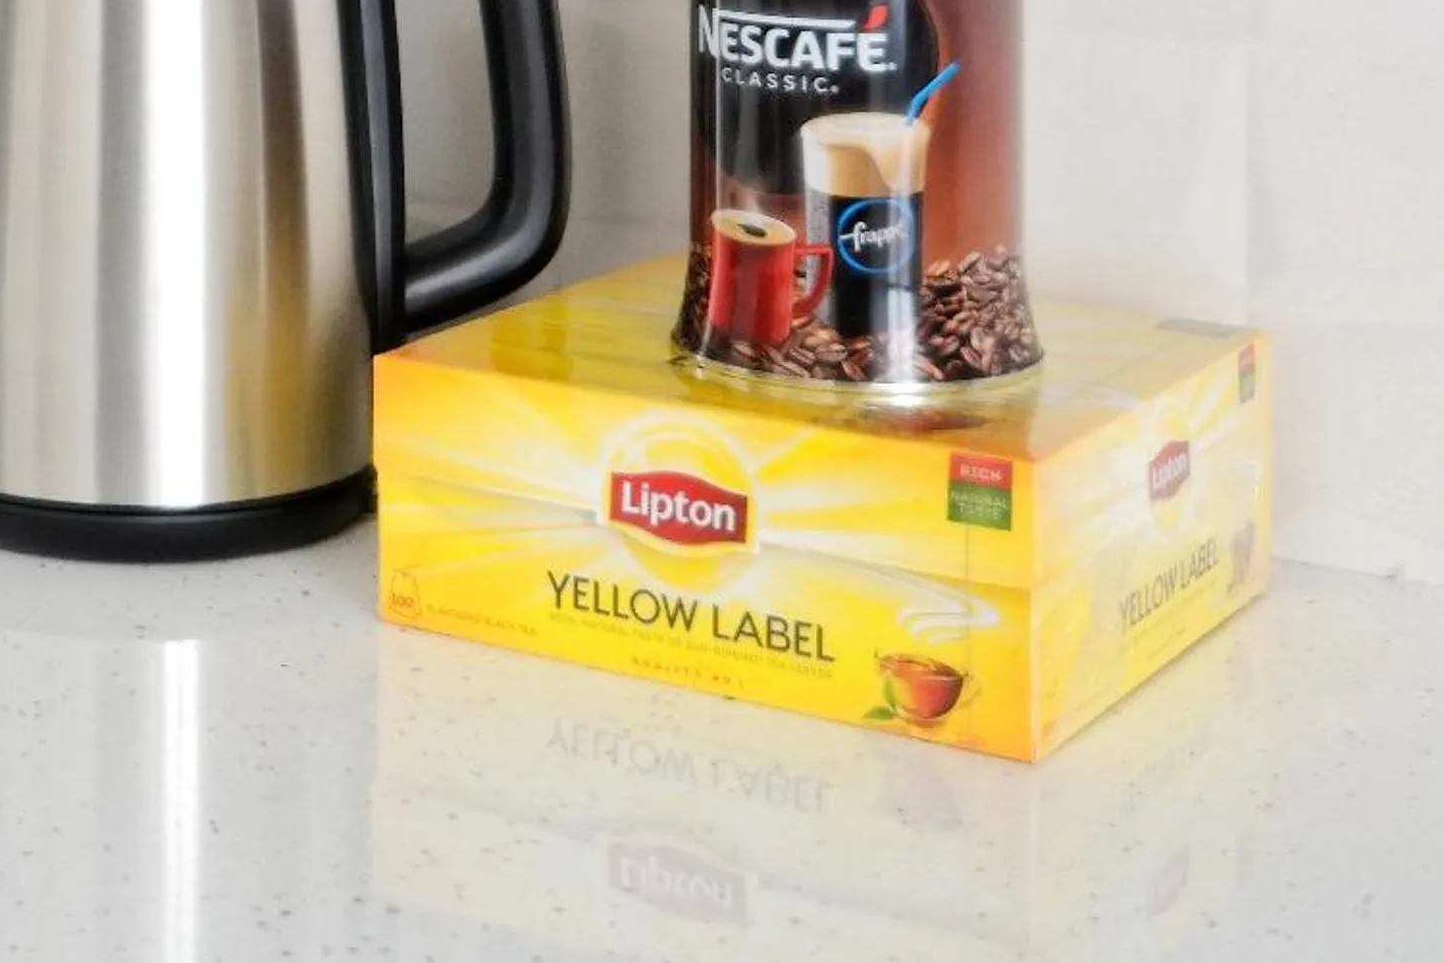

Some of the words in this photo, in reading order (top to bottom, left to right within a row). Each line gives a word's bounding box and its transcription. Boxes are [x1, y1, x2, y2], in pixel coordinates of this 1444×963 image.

[698, 4, 890, 72] NESCAFÉ
[721, 67, 831, 95] CLASSIC
[959, 462, 1004, 483] RICH
[620, 480, 737, 533] Lipton
[1118, 562, 1178, 636] YELLOW
[1179, 535, 1220, 590] LABEL
[547, 569, 699, 633] YELLOW
[712, 602, 836, 663] LABEL
